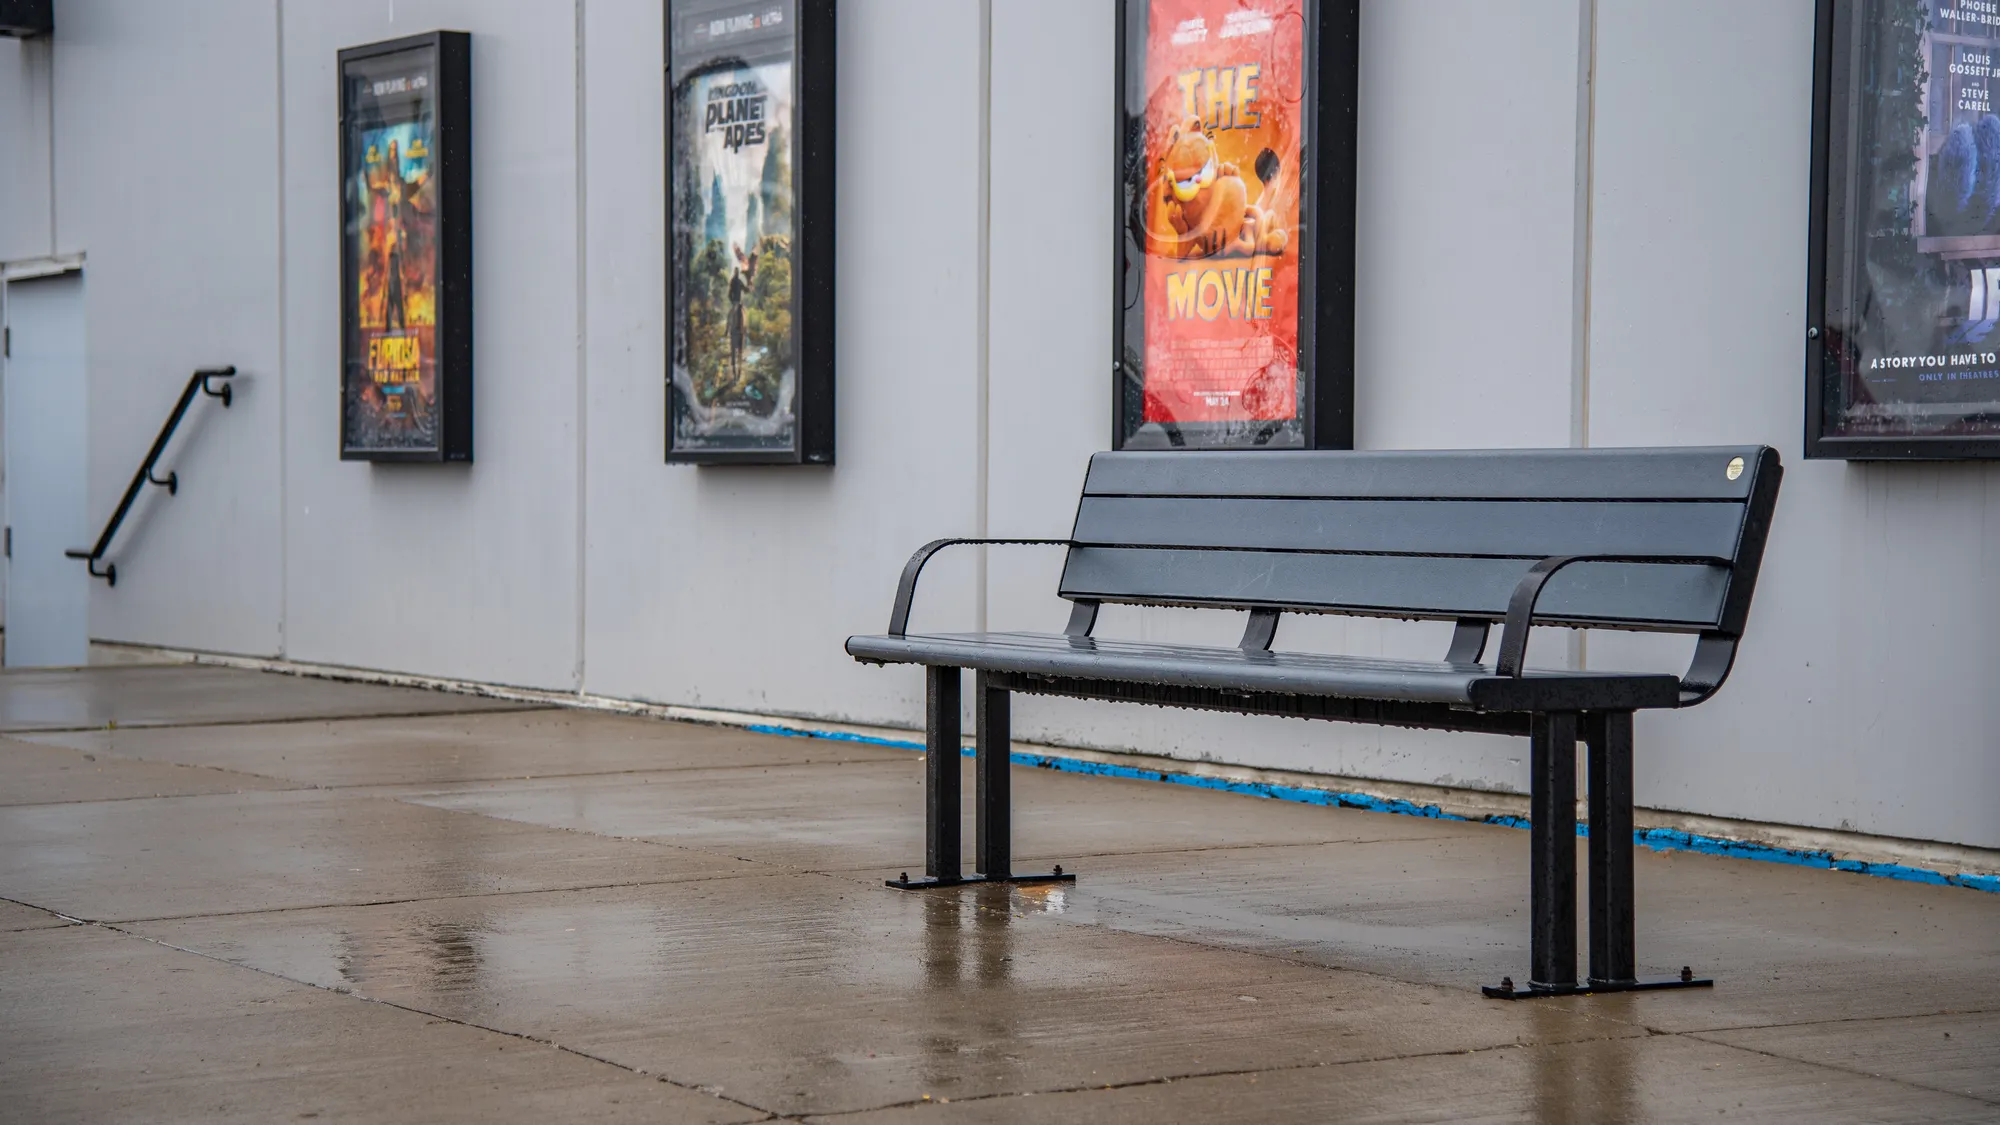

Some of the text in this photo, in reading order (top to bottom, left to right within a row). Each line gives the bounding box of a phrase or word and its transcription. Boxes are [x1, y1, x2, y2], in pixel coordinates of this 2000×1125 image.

[1960, 0, 1997, 14] PHOEBE
[1962, 52, 1991, 66] LOUIS
[1949, 63, 1991, 78] GOSSETT
[707, 80, 758, 101] KINGDOM
[1177, 61, 1261, 131] THE
[1961, 87, 1990, 100] STEVE
[705, 95, 768, 133] PLANET
[1958, 99, 1991, 112] CARELL
[723, 121, 766, 154] APES
[1166, 267, 1274, 323] MOVIE
[368, 336, 421, 370] FURIOSA
[1870, 352, 1997, 370] A STORY YOU HAVE TO
[1918, 370, 2000, 382] ONLY IN THEATRES
